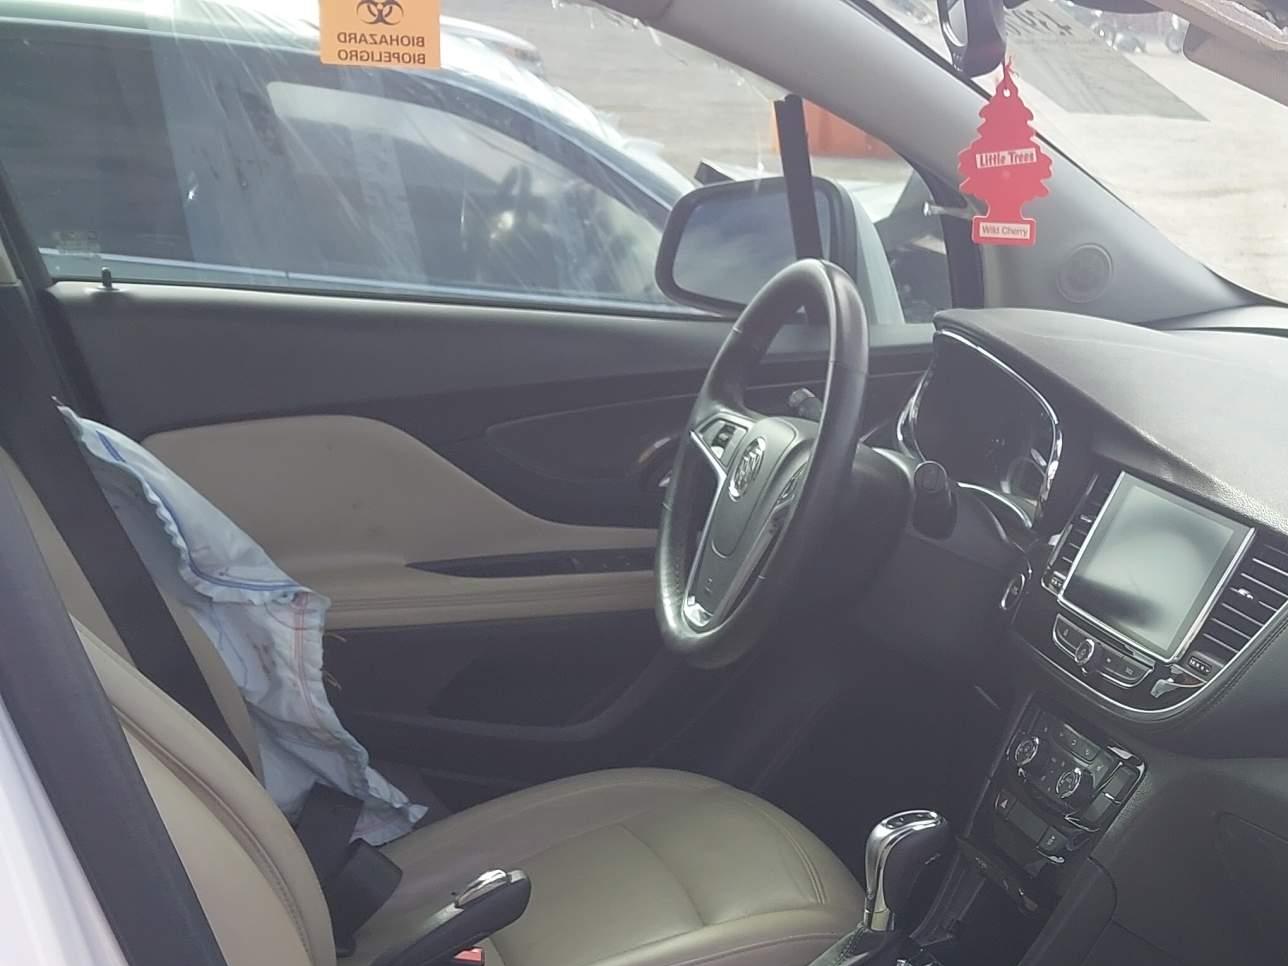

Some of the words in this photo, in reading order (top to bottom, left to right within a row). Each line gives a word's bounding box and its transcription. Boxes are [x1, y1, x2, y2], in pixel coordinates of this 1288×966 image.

[980, 153, 1006, 167] Little
[1008, 151, 1034, 164] Trees
[982, 224, 1000, 234] Wild
[1001, 225, 1028, 238] Cherry
